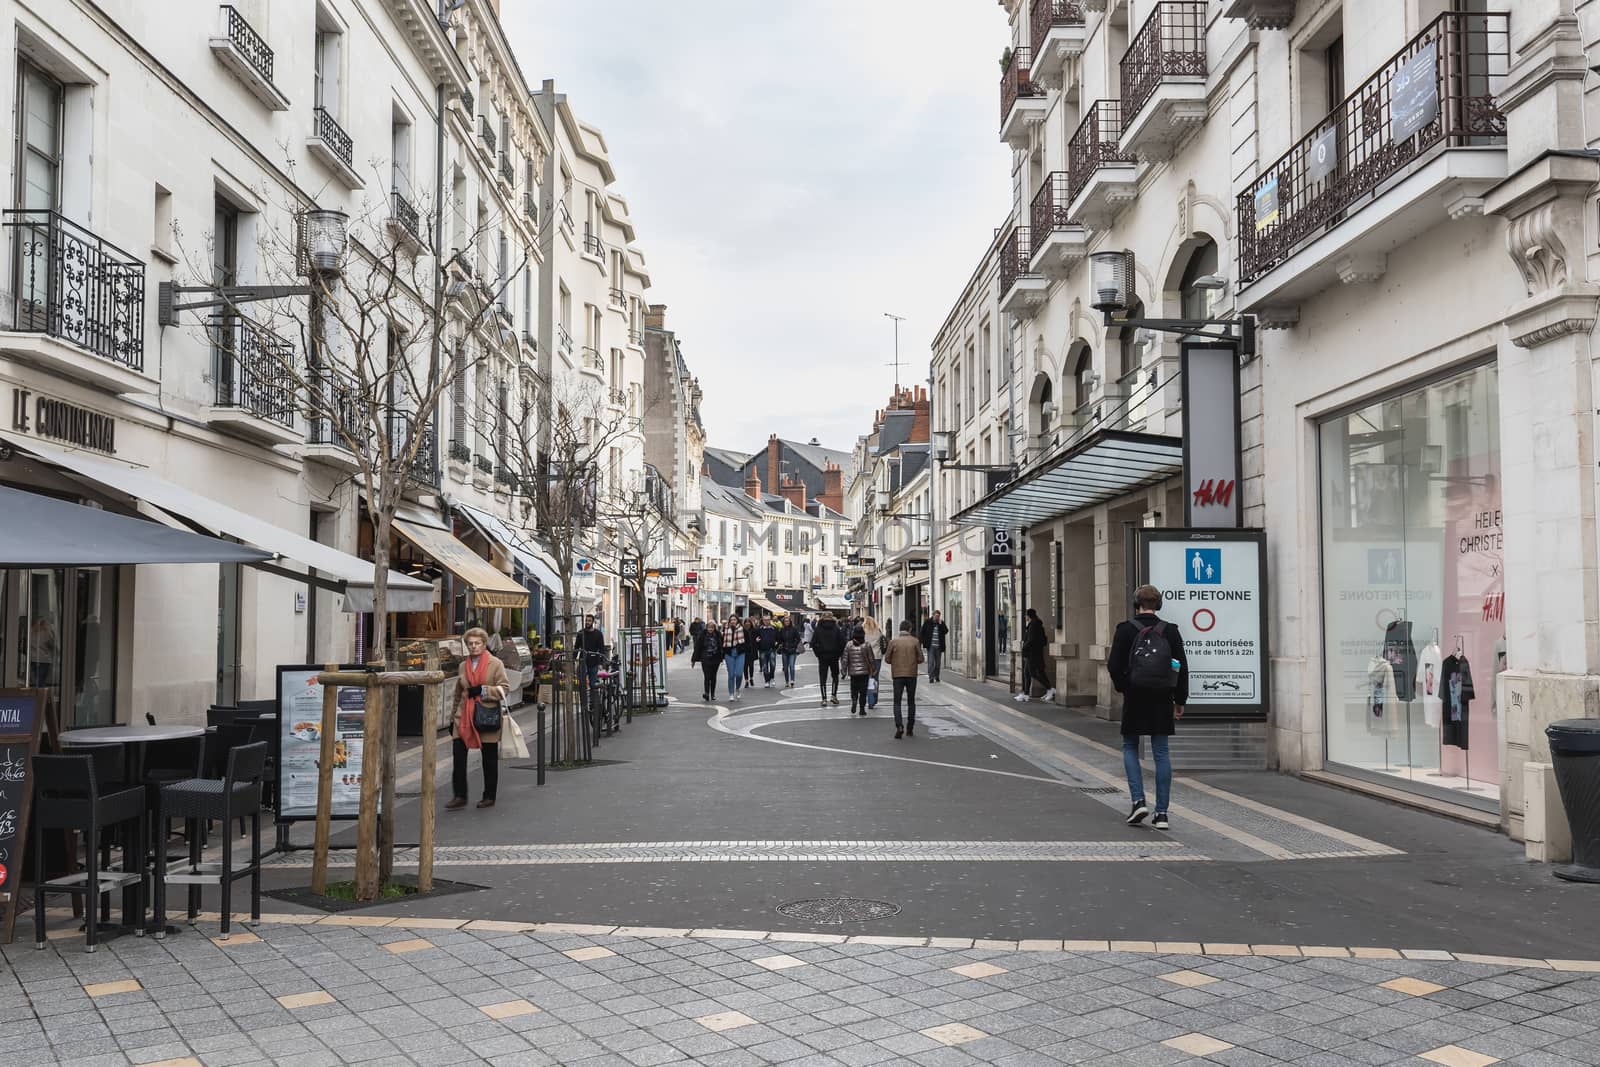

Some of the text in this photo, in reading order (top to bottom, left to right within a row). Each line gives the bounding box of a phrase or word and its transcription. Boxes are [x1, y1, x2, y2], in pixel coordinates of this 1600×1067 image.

[12, 388, 117, 455] LE CONTINENTAL
[1193, 479, 1235, 507] H&M
[1189, 590, 1252, 601] PIETONNE
[1205, 638, 1254, 647] autorisées
